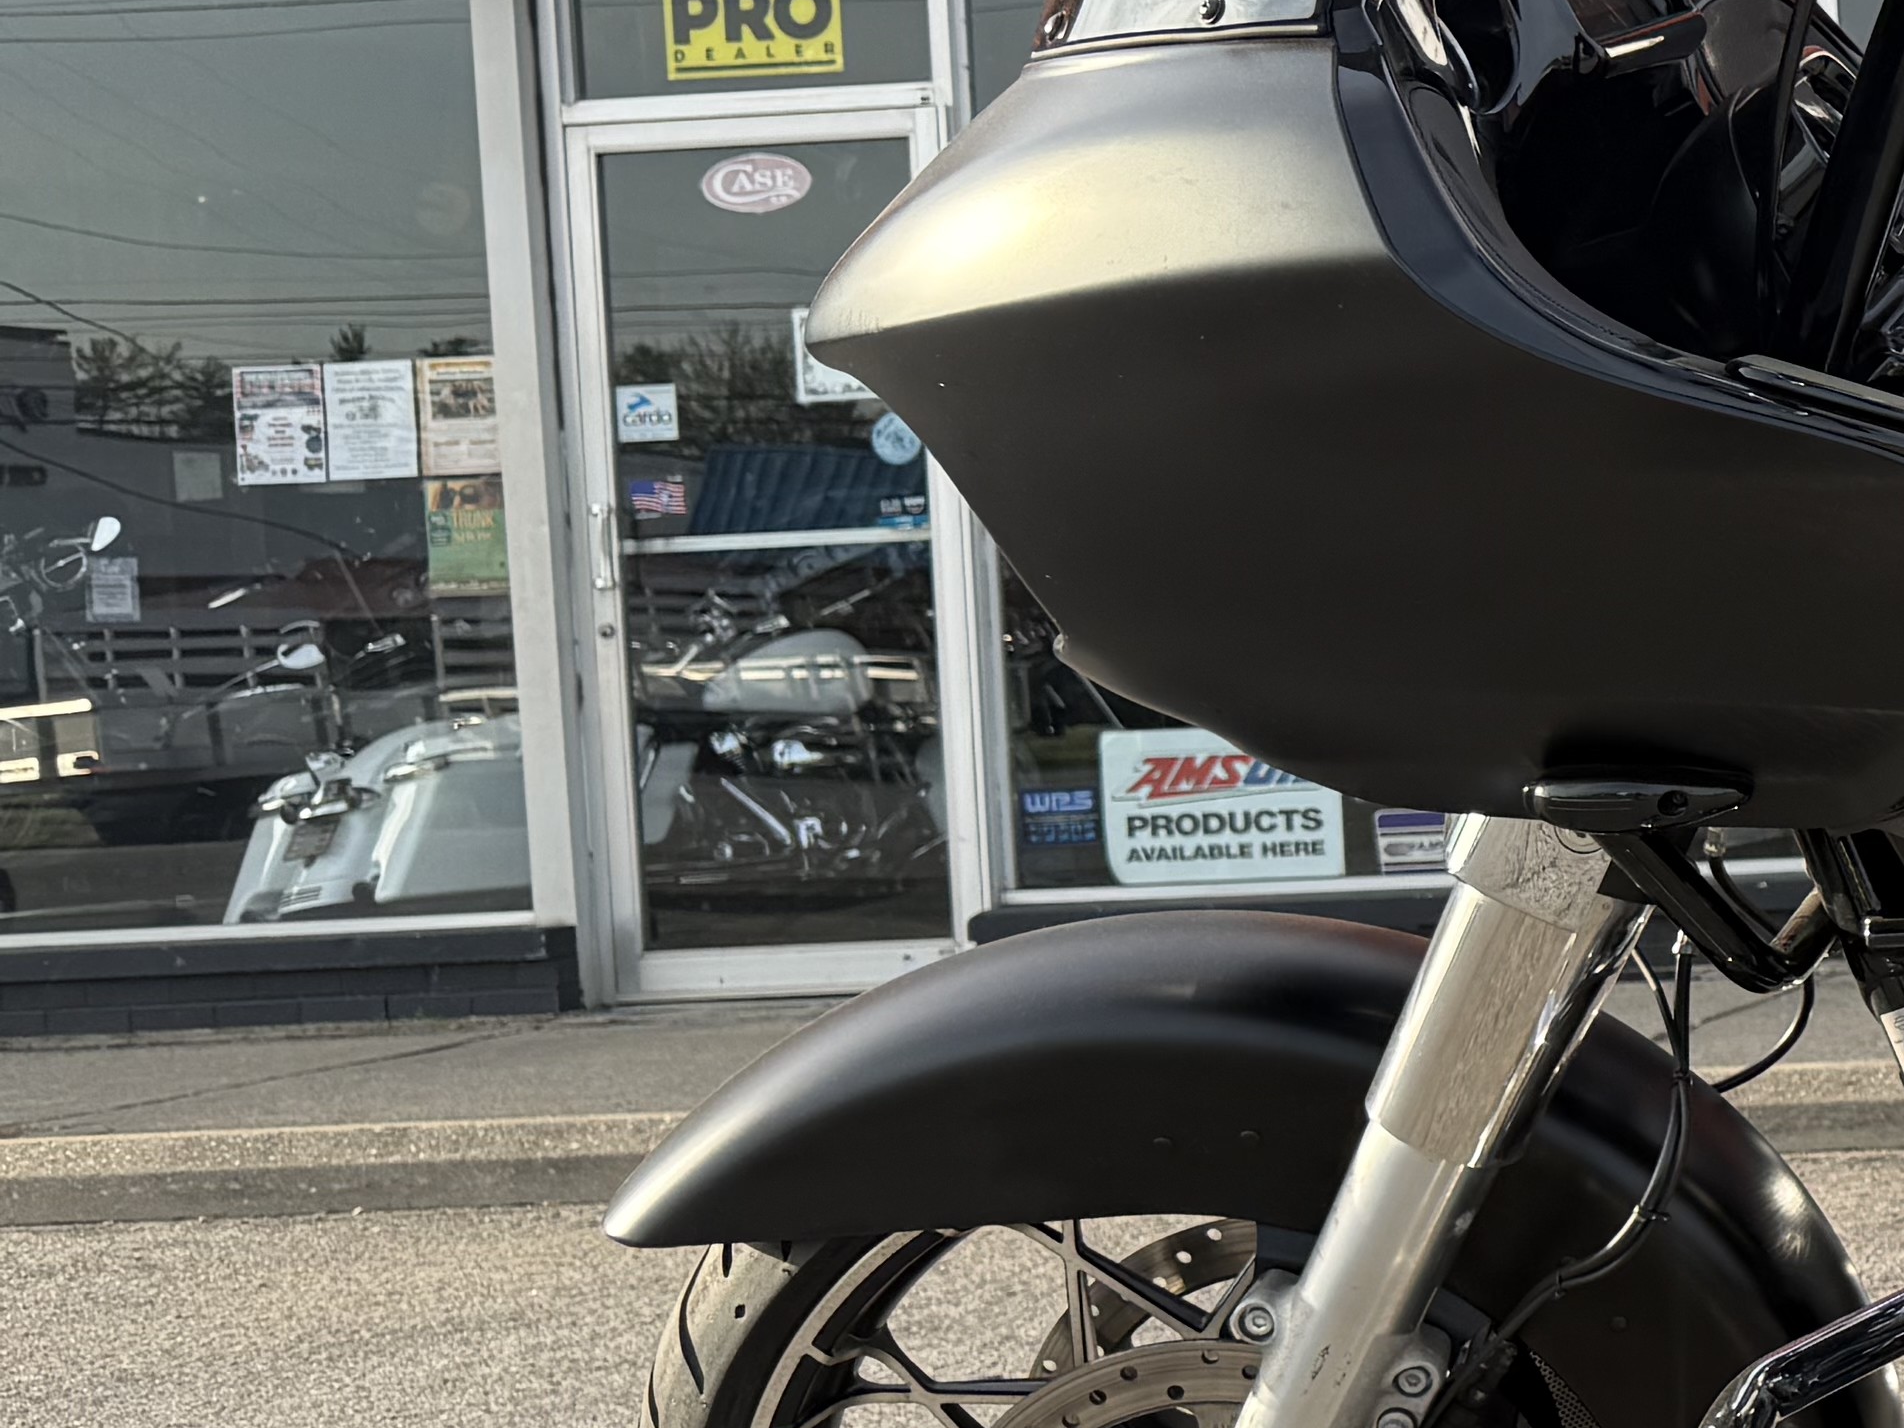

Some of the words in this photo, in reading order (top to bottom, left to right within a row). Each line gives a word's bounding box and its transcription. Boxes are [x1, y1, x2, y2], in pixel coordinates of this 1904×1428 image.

[674, 41, 836, 63] DEALER
[713, 163, 800, 204] CASE
[1126, 754, 1312, 800] AMSO
[1127, 808, 1324, 838] PRODUCTS
[1127, 842, 1253, 863] AVAILABLE
[1262, 839, 1325, 859] HERE
